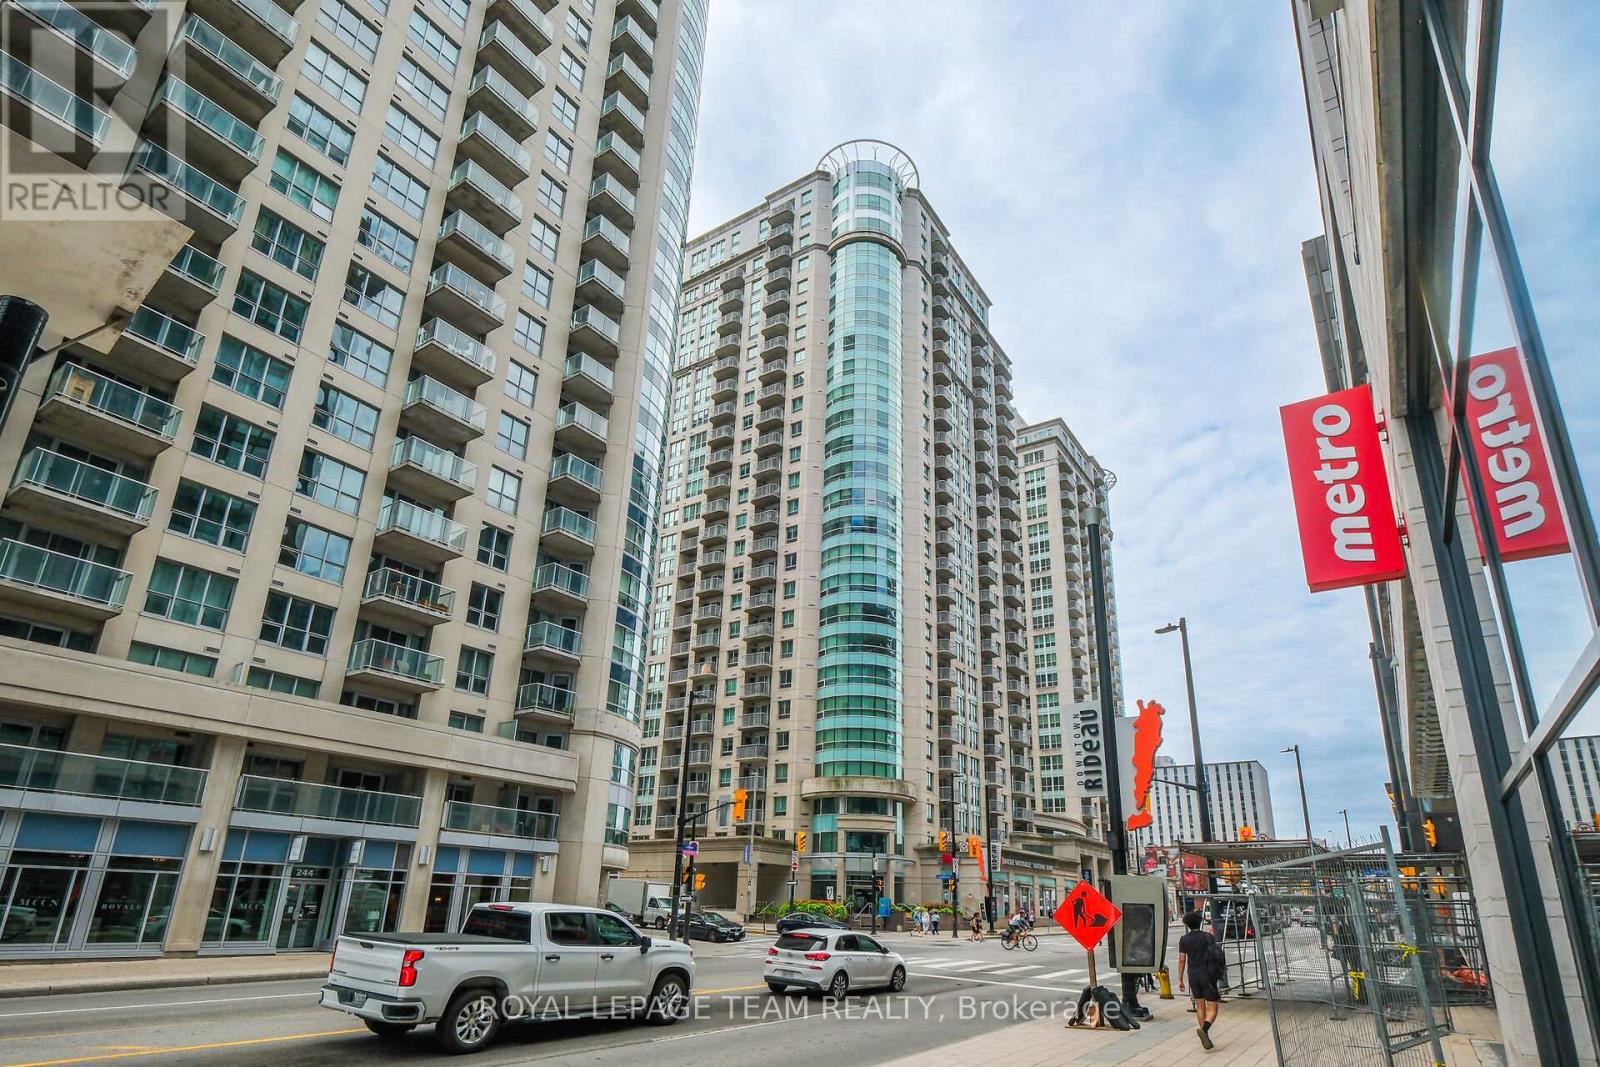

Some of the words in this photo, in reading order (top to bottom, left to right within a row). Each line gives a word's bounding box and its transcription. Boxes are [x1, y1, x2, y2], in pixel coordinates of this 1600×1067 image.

[1312, 404, 1377, 563] metro
[1072, 713, 1085, 786] DOWNTOWN
[295, 868, 314, 877] 244
